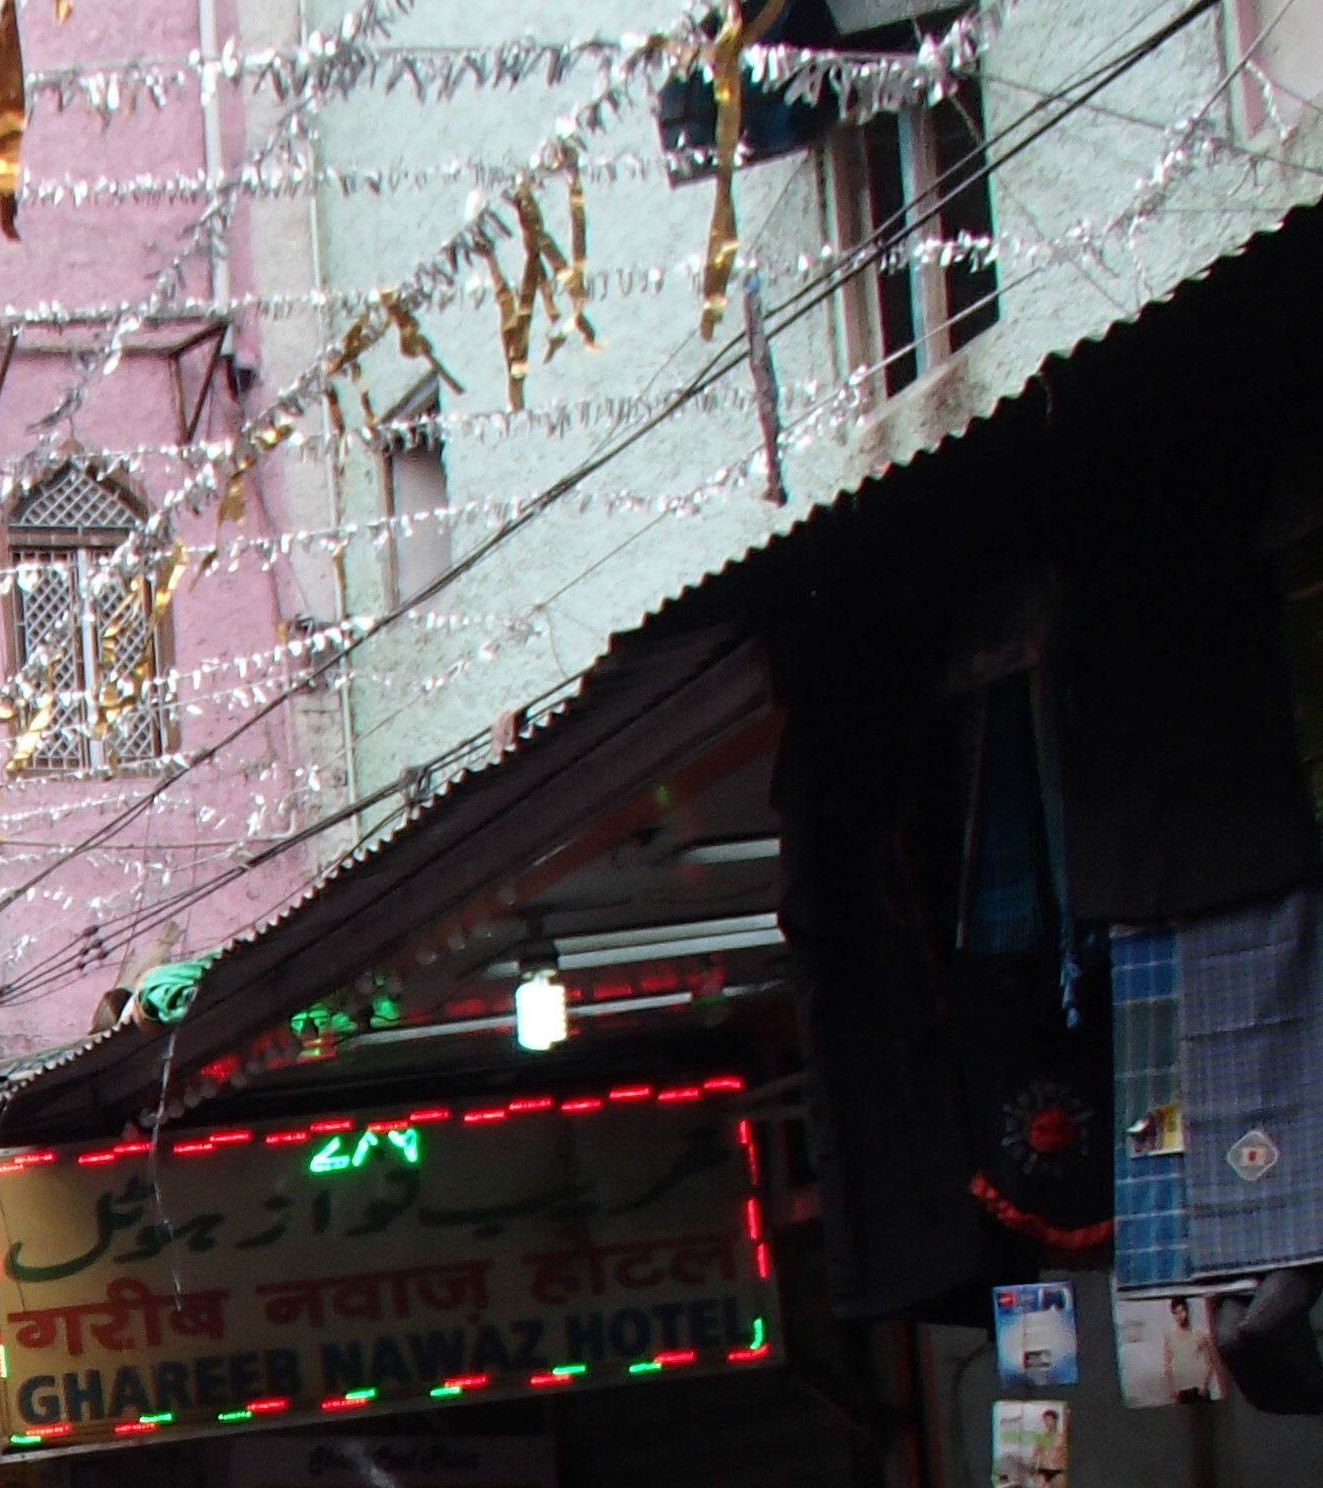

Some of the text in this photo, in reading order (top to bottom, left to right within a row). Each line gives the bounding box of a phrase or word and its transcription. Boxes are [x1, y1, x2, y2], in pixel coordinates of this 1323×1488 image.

[8, 1223, 744, 1355] गरीब नवाज़ होटल
[18, 1296, 749, 1424] GHAREEB NAWAZ HOTEL
